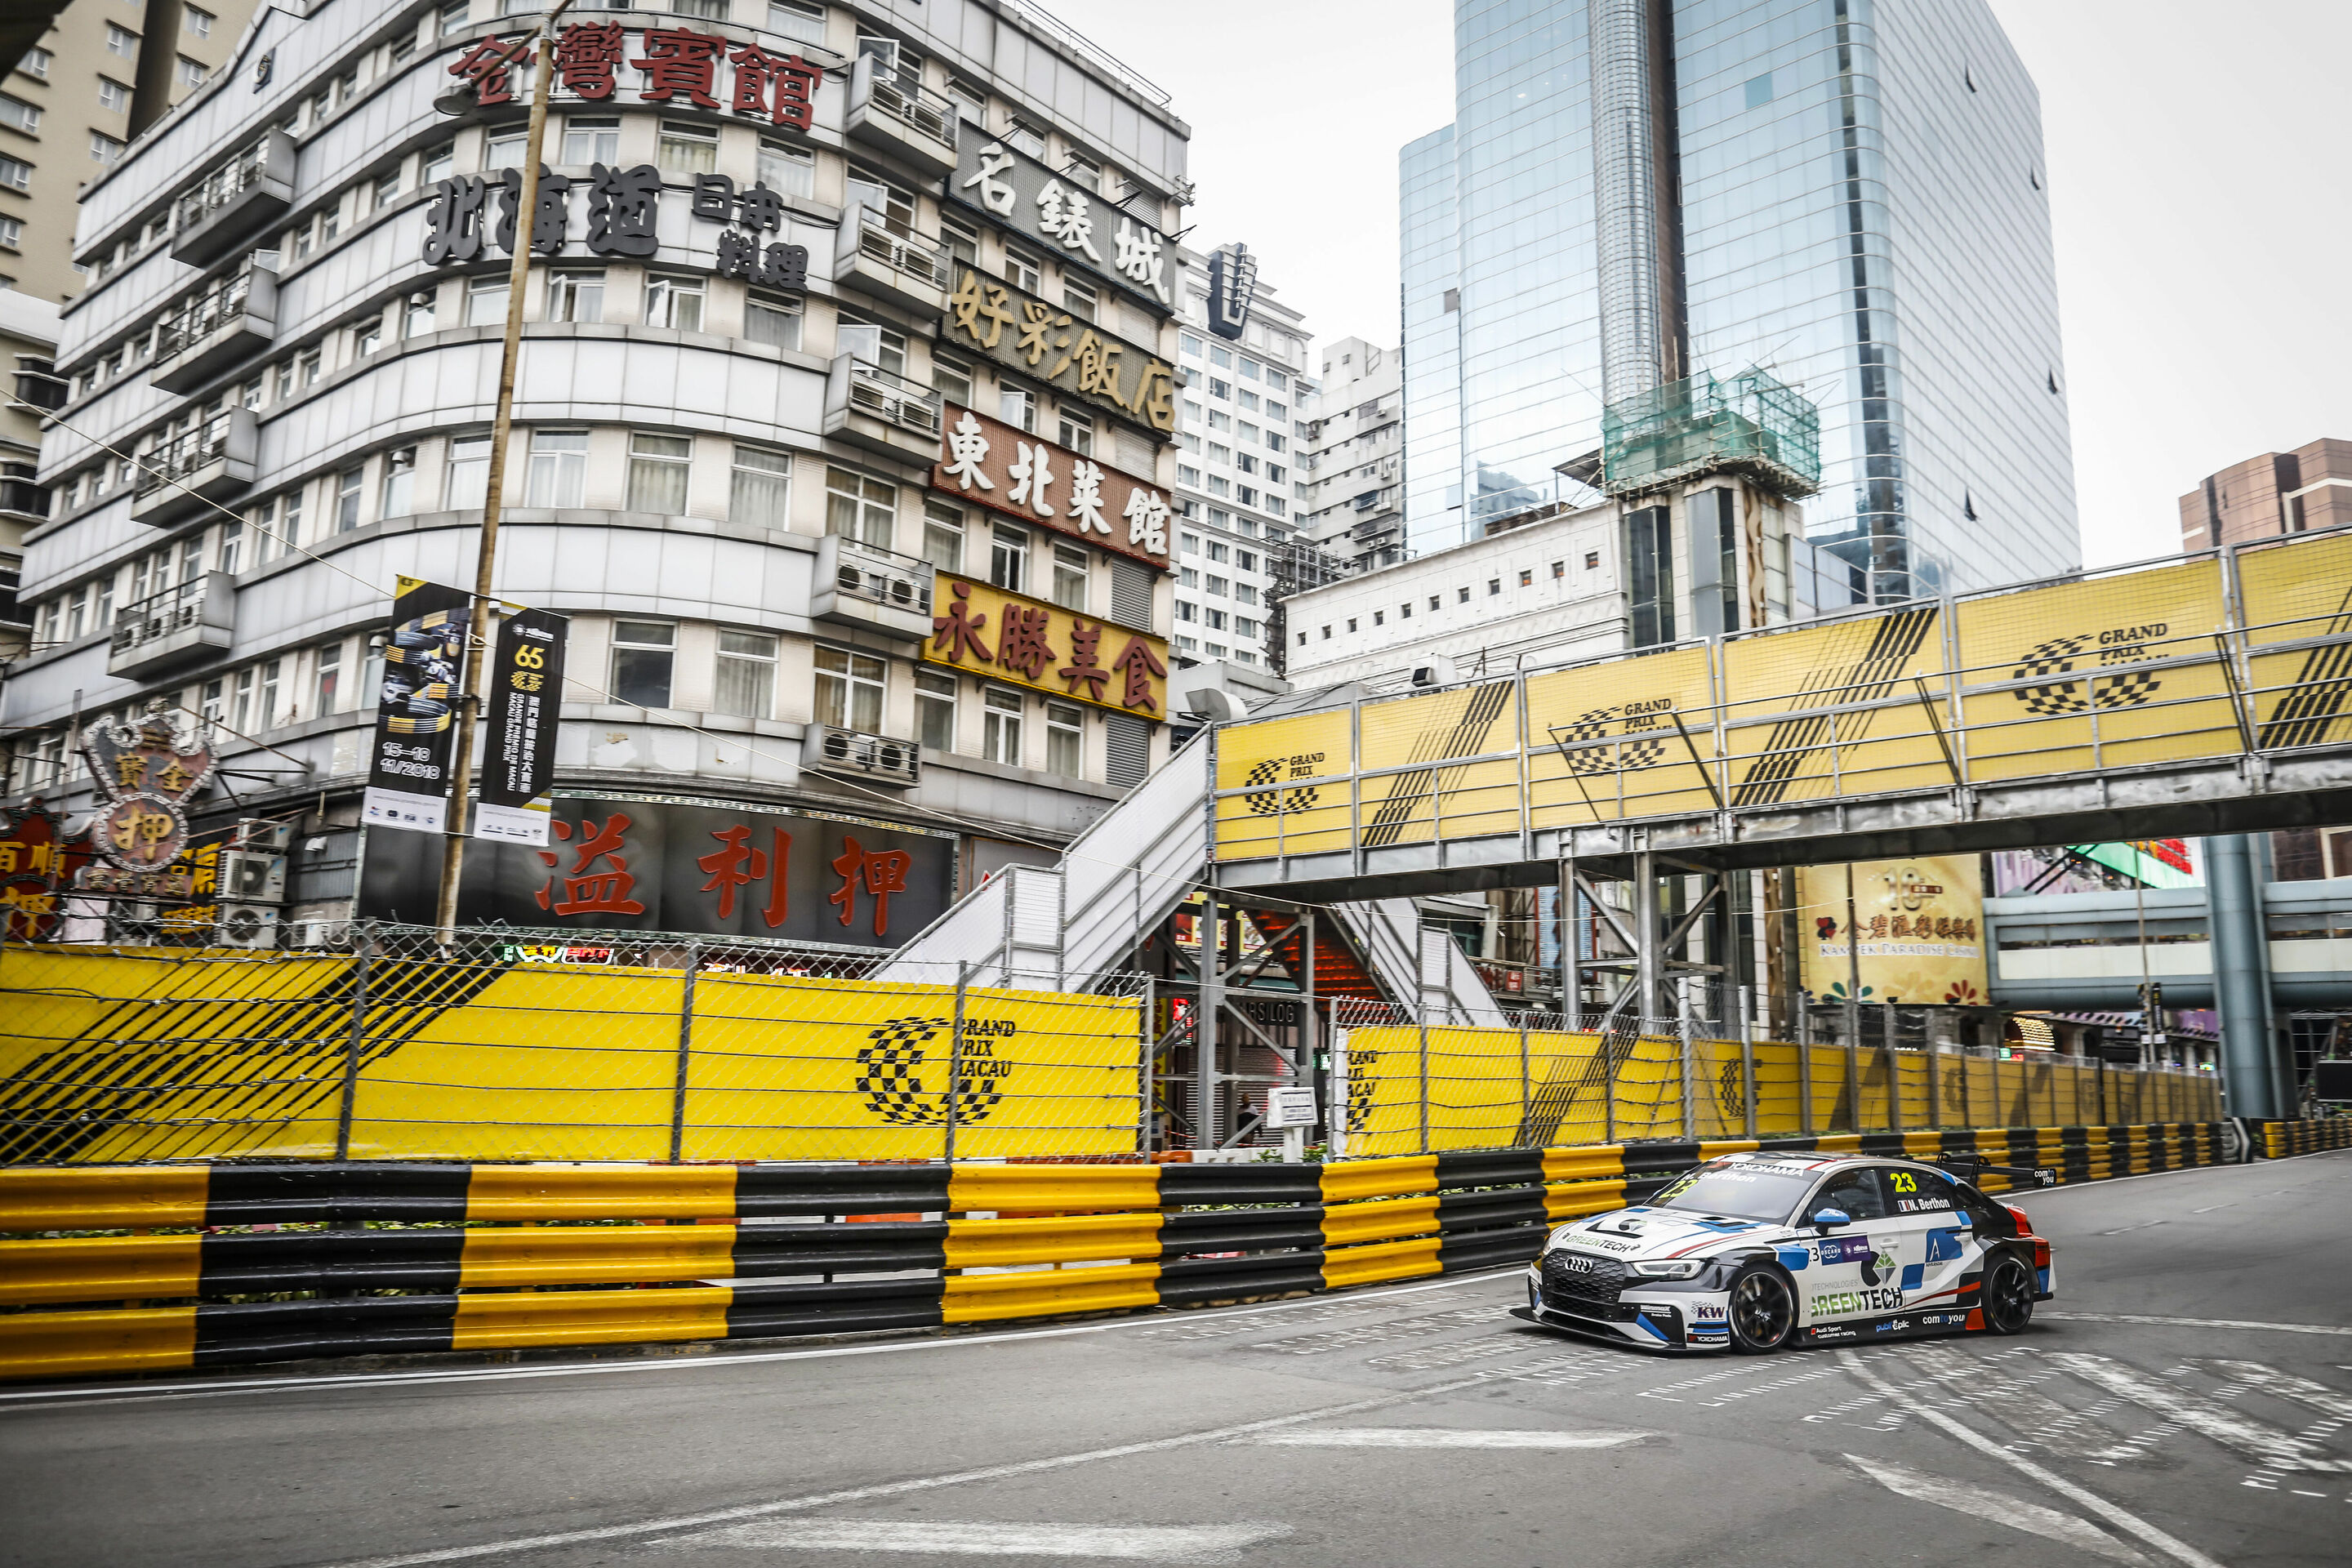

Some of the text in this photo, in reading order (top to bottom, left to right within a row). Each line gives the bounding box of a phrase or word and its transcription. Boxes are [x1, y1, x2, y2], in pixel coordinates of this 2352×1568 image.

[692, 172, 783, 231] 日本
[422, 162, 661, 265] 北海道
[716, 228, 808, 292] 料理
[951, 270, 1176, 433] 好彩飯店
[942, 411, 1171, 555] 東北菜館
[2099, 623, 2167, 644] GRAND
[933, 581, 1168, 710] 永勝美食
[2100, 642, 2145, 660] PRIX
[514, 644, 544, 670] 65
[514, 693, 524, 724] GRANDE
[1625, 698, 1671, 715] GRAND
[502, 692, 517, 761] MACAU GRAND PRIX
[1624, 715, 1656, 728] PRIX
[509, 755, 518, 764] DE
[1290, 752, 1325, 766] GRAND
[507, 765, 517, 791] MACAU
[1290, 765, 1313, 777] PRIX
[535, 813, 912, 938] 溢利押
[959, 1018, 1016, 1037] RAND
[1728, 1163, 1804, 1177] YOKOHAMA
[1659, 1179, 1699, 1199] 23
[1890, 1173, 1917, 1193] 23
[2042, 1175, 2054, 1186] you
[1909, 1197, 1950, 1212] N. Berthon
[1566, 1235, 1631, 1253] GREENTECH
[1820, 1248, 1842, 1256] OSCARO
[1698, 1307, 1725, 1318] KW
